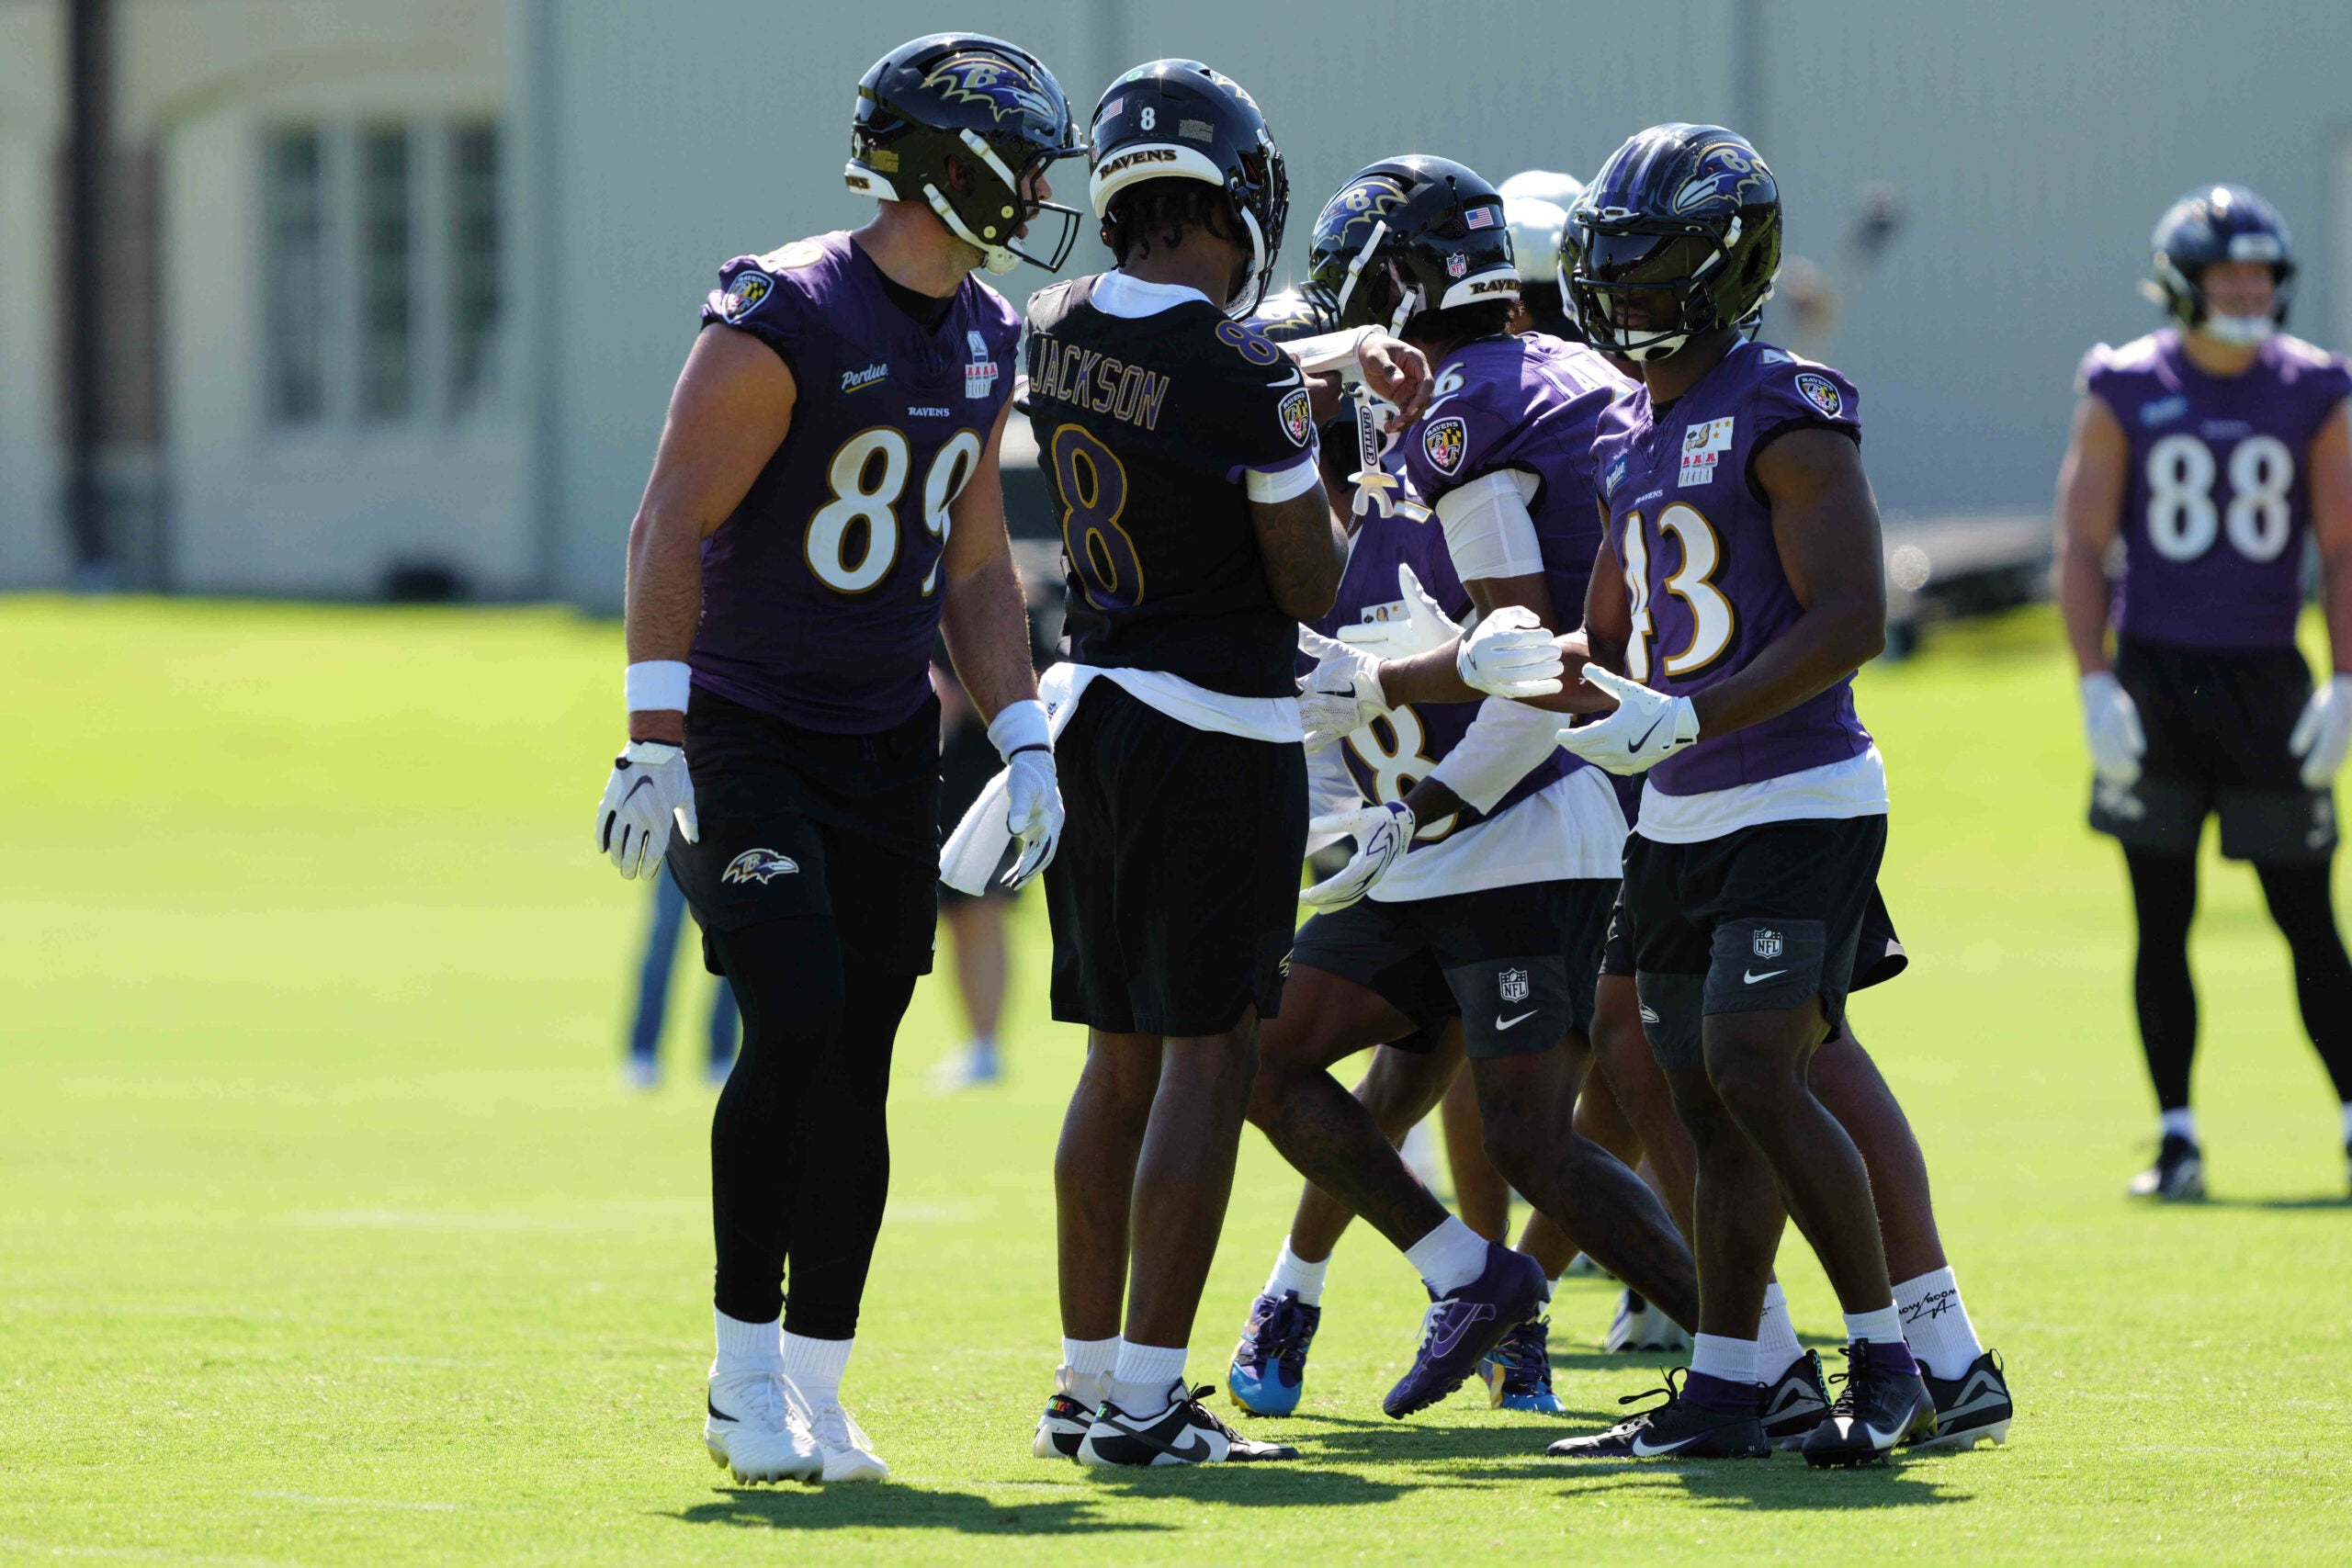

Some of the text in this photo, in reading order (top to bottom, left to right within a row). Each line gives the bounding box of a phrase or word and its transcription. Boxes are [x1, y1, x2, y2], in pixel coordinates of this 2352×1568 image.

[1140, 107, 1156, 130] 8
[1099, 150, 1177, 181] RAVENS
[1216, 319, 1279, 367] 8
[842, 363, 886, 390] Perdue
[1030, 337, 1170, 432] JACKSON
[908, 407, 950, 417] RAVENS
[1283, 392, 1306, 410] RAVENS
[1362, 411, 1375, 462] BATTLE
[1427, 421, 1459, 437] RAVENS
[803, 424, 982, 597] 89
[1634, 489, 1664, 505] RAVENS
[2146, 434, 2295, 562] 88
[1051, 423, 1145, 610] 8
[1757, 939, 1781, 955] NFL
[1503, 983, 1527, 998] NFL
